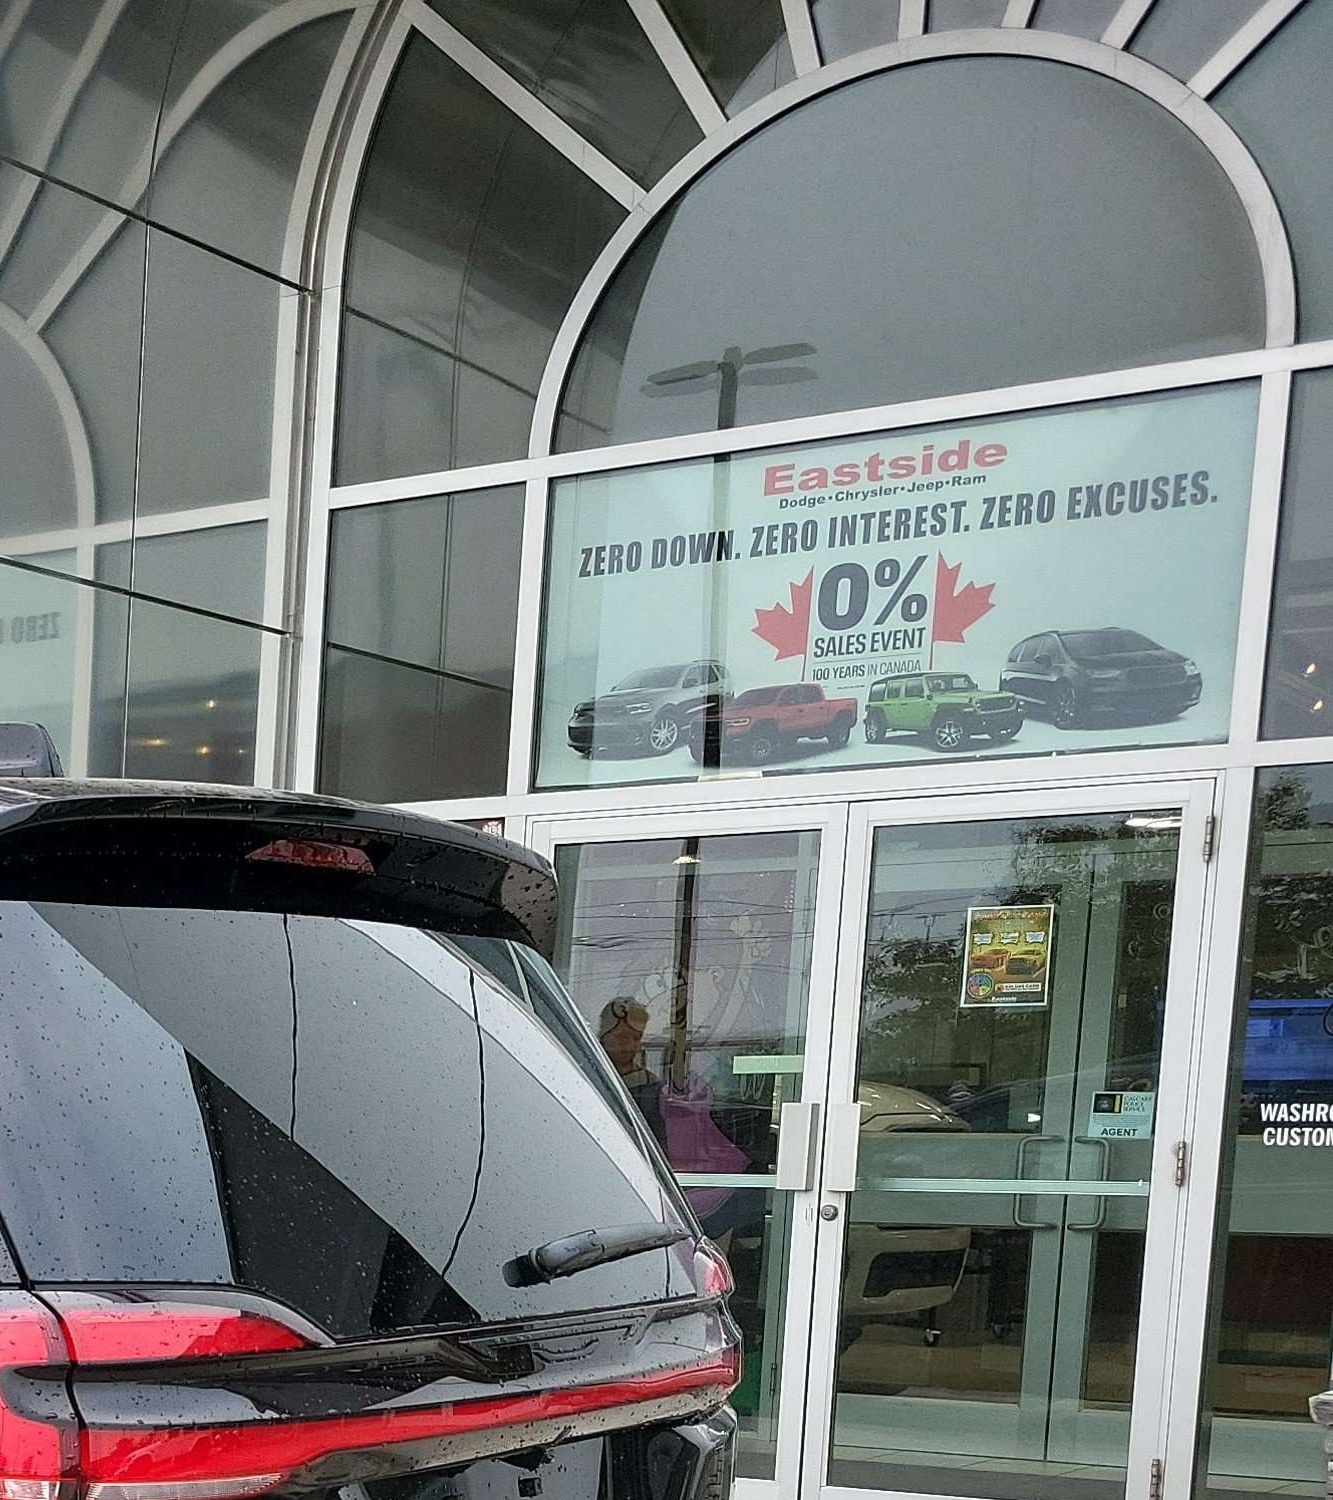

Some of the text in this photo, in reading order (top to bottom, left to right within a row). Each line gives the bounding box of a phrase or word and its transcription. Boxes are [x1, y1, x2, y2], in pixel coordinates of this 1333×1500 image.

[764, 440, 1008, 496] Eastside
[578, 470, 1219, 578] ZERO DOWN. ZERO INTEREST. ZERO EXCUSES.
[817, 554, 929, 631] 0%
[813, 627, 926, 658] SALES EVENT
[813, 660, 922, 681] 100 YEARS IN CANADA
[1260, 1103, 1333, 1122] WASHR
[1101, 1127, 1139, 1137] AGENT
